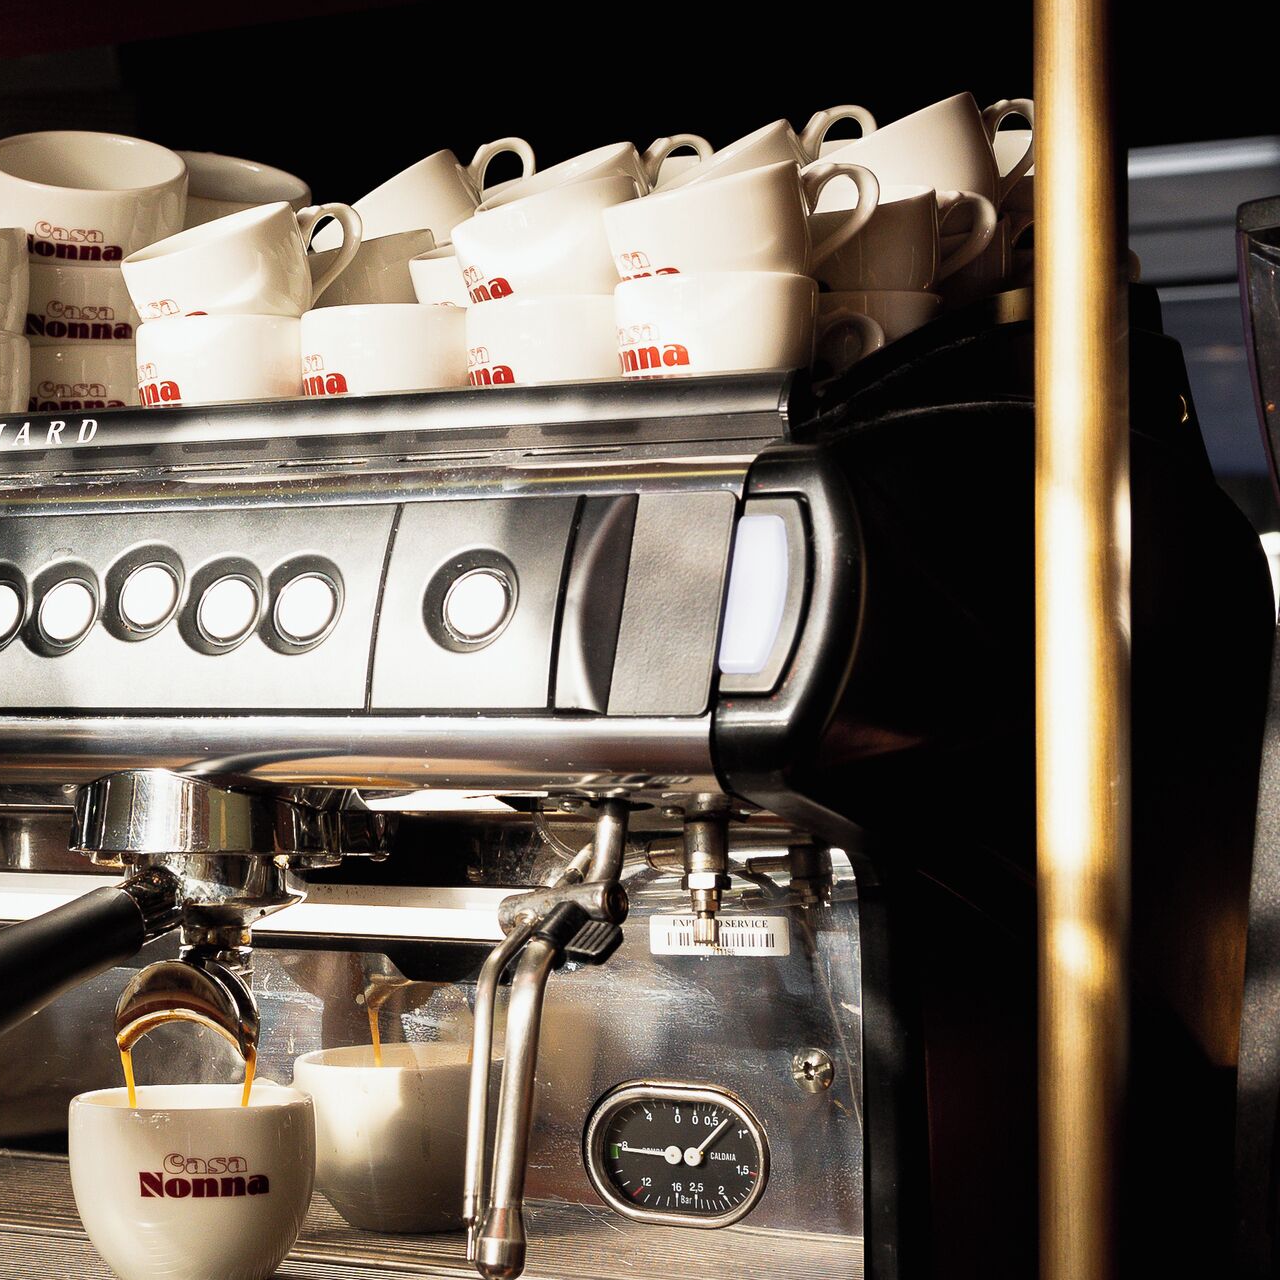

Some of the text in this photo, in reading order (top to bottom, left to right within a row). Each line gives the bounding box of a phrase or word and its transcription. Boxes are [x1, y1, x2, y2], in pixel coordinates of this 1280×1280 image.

[35, 221, 104, 244] Casa
[46, 300, 115, 321] Casa
[25, 313, 133, 340] Nonna
[37, 381, 107, 398] Casa
[725, 919, 768, 928] SERVICE
[674, 1114, 681, 1123] 0
[692, 1116, 698, 1124] 0
[704, 1116, 718, 1127] 0,5
[710, 1152, 736, 1161] CALDAIA
[163, 1153, 248, 1174] Casa
[736, 1165, 749, 1175] 1,5
[139, 1172, 270, 1199] Nonna
[642, 1178, 652, 1187] 12
[671, 1183, 682, 1192] 16
[689, 1183, 704, 1193] 2,5
[718, 1186, 725, 1195] 2
[681, 1195, 693, 1204] Bar
